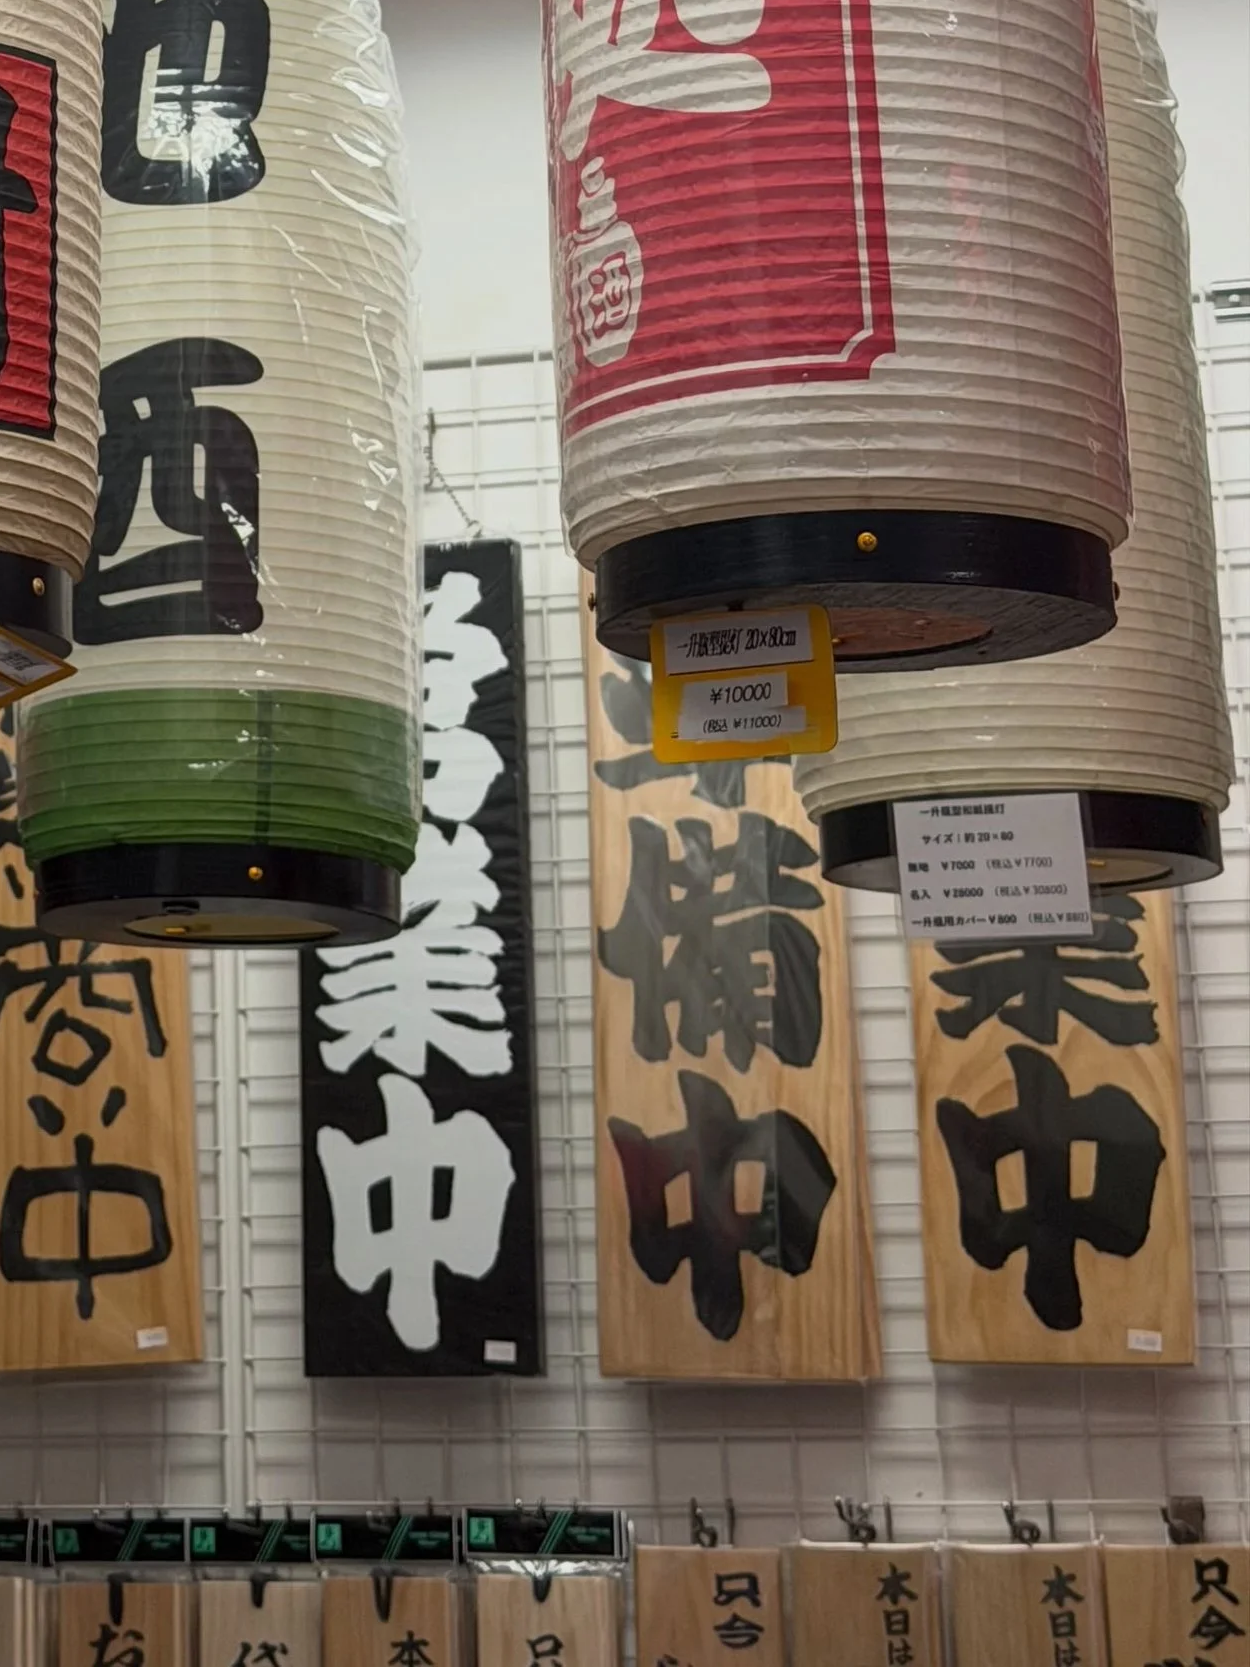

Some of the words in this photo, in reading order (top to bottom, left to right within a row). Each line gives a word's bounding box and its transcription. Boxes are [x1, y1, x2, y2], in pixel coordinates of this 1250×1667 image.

[710, 682, 772, 705] ¥10000
[713, 1571, 765, 1649] 只今
[875, 1562, 919, 1667] 本日は
[1040, 1564, 1085, 1667] 本日は
[1188, 1556, 1247, 1651] 只今
